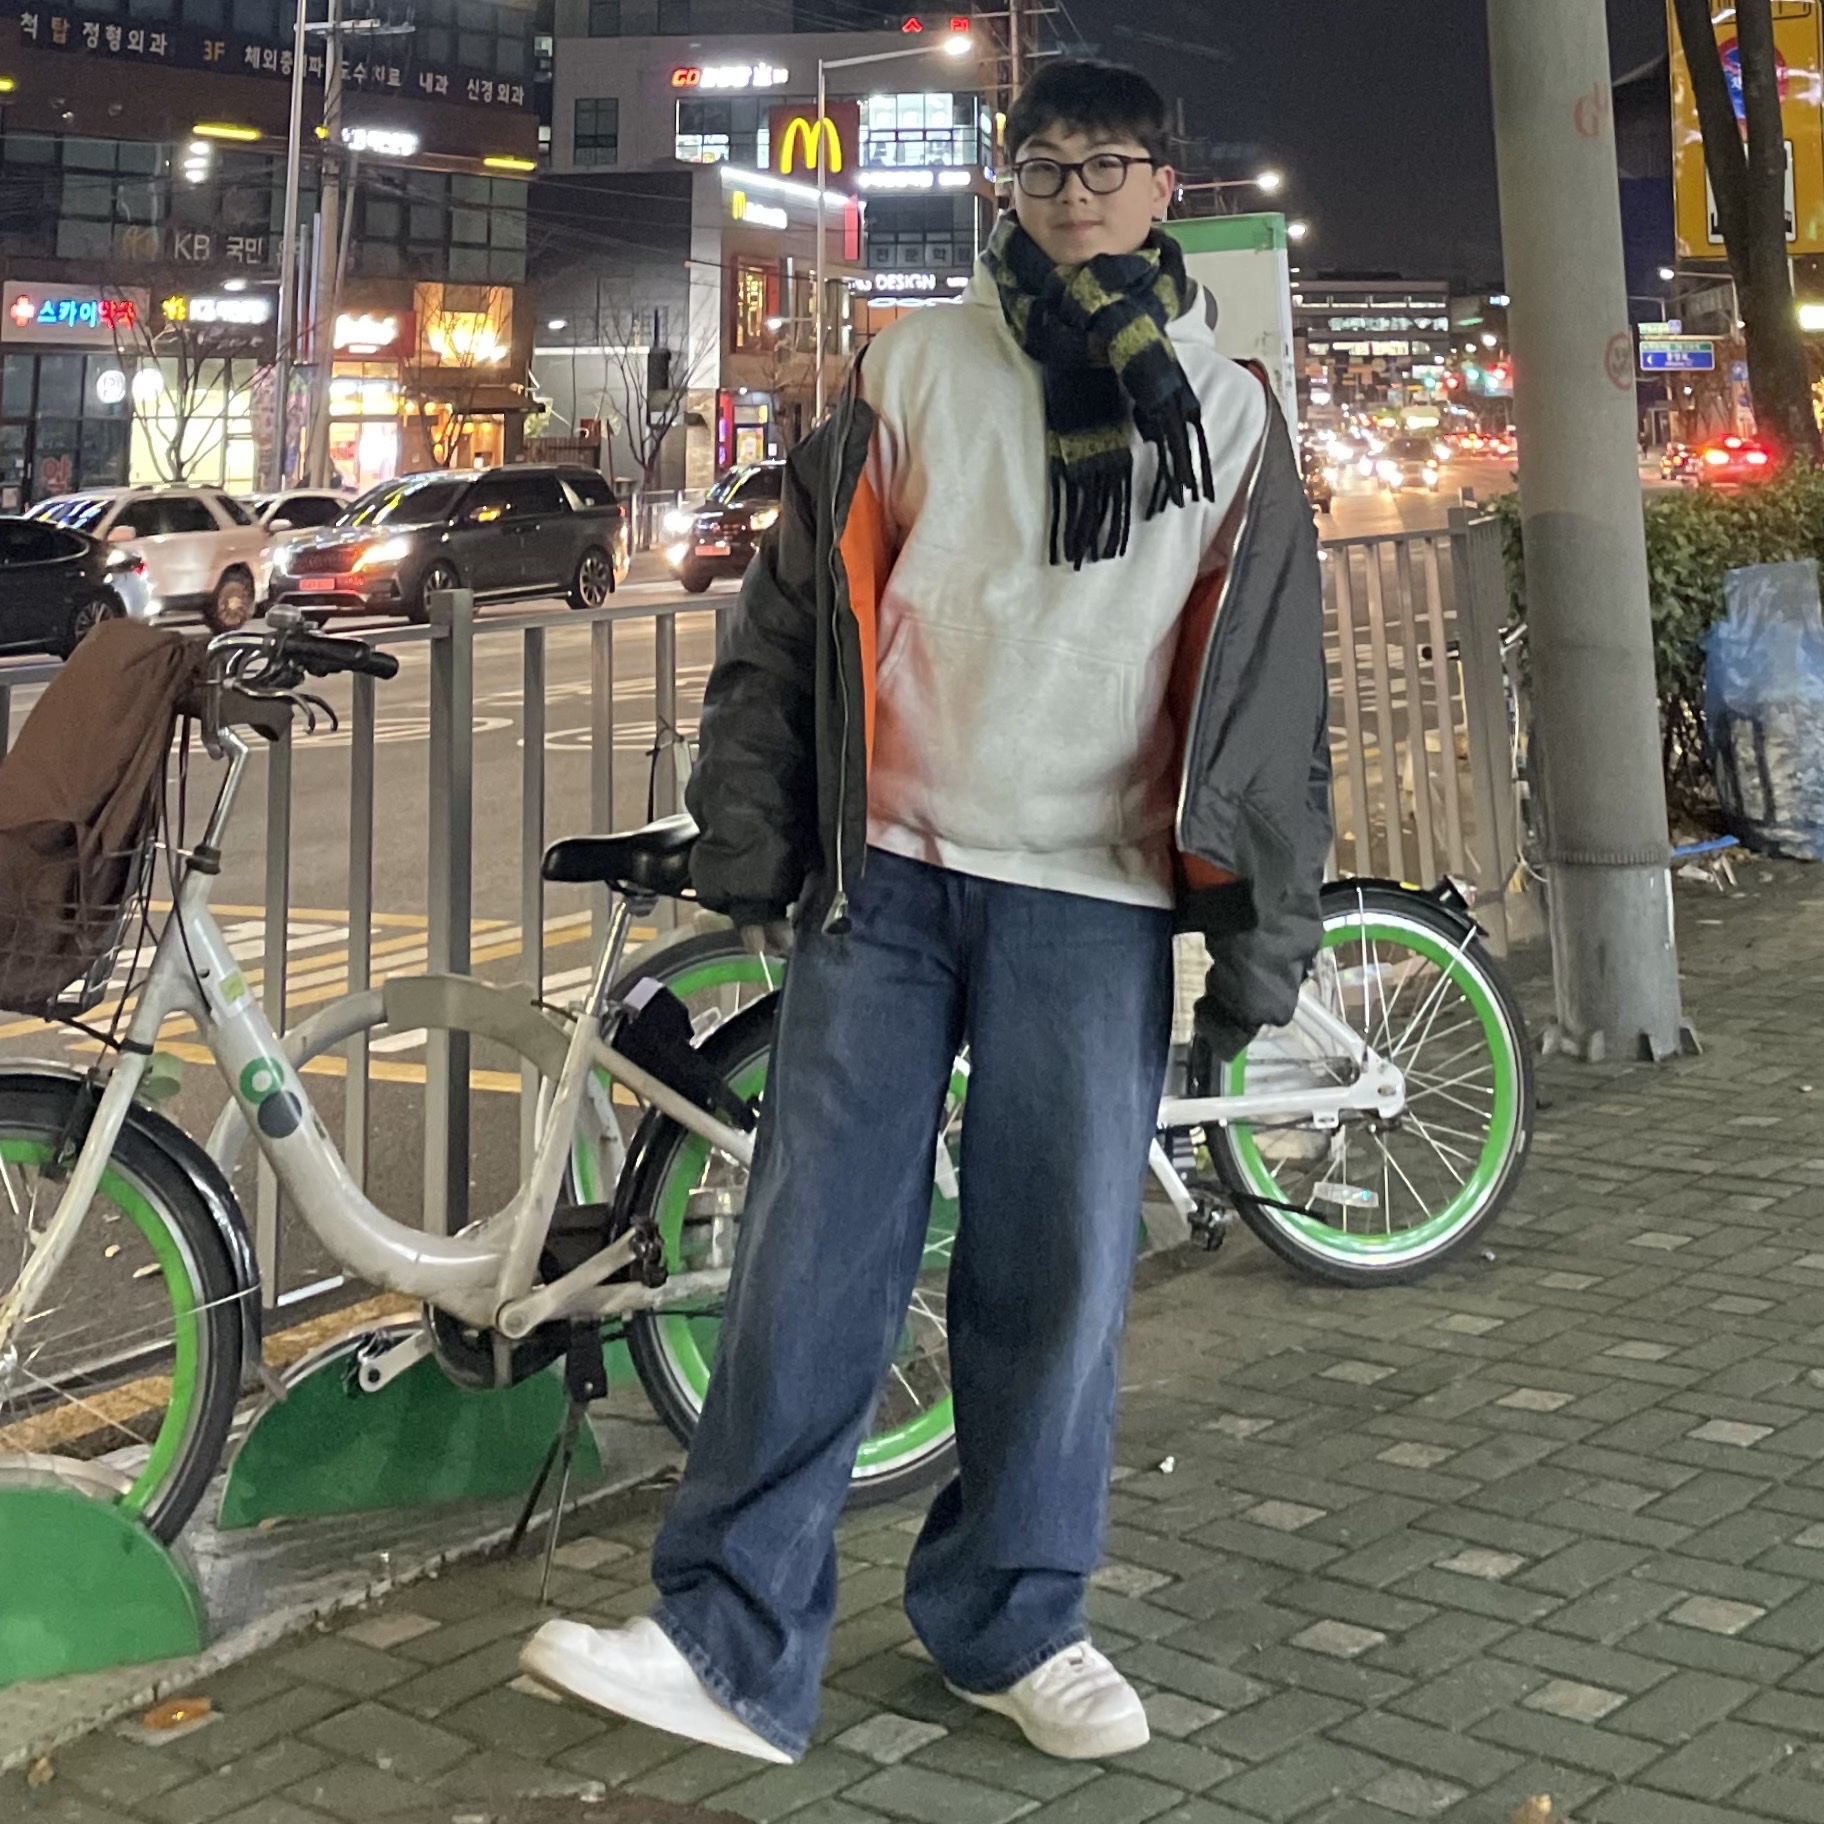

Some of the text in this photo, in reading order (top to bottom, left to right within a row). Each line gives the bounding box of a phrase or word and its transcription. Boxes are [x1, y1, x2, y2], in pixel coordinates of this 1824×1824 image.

[82, 22, 168, 56] 정형외과
[203, 40, 226, 62] 3F
[244, 45, 324, 78] 체외충파
[419, 72, 449, 95] 내과
[466, 77, 525, 106] 신경외과
[174, 233, 210, 261] KB
[875, 273, 936, 291] DESIGN
